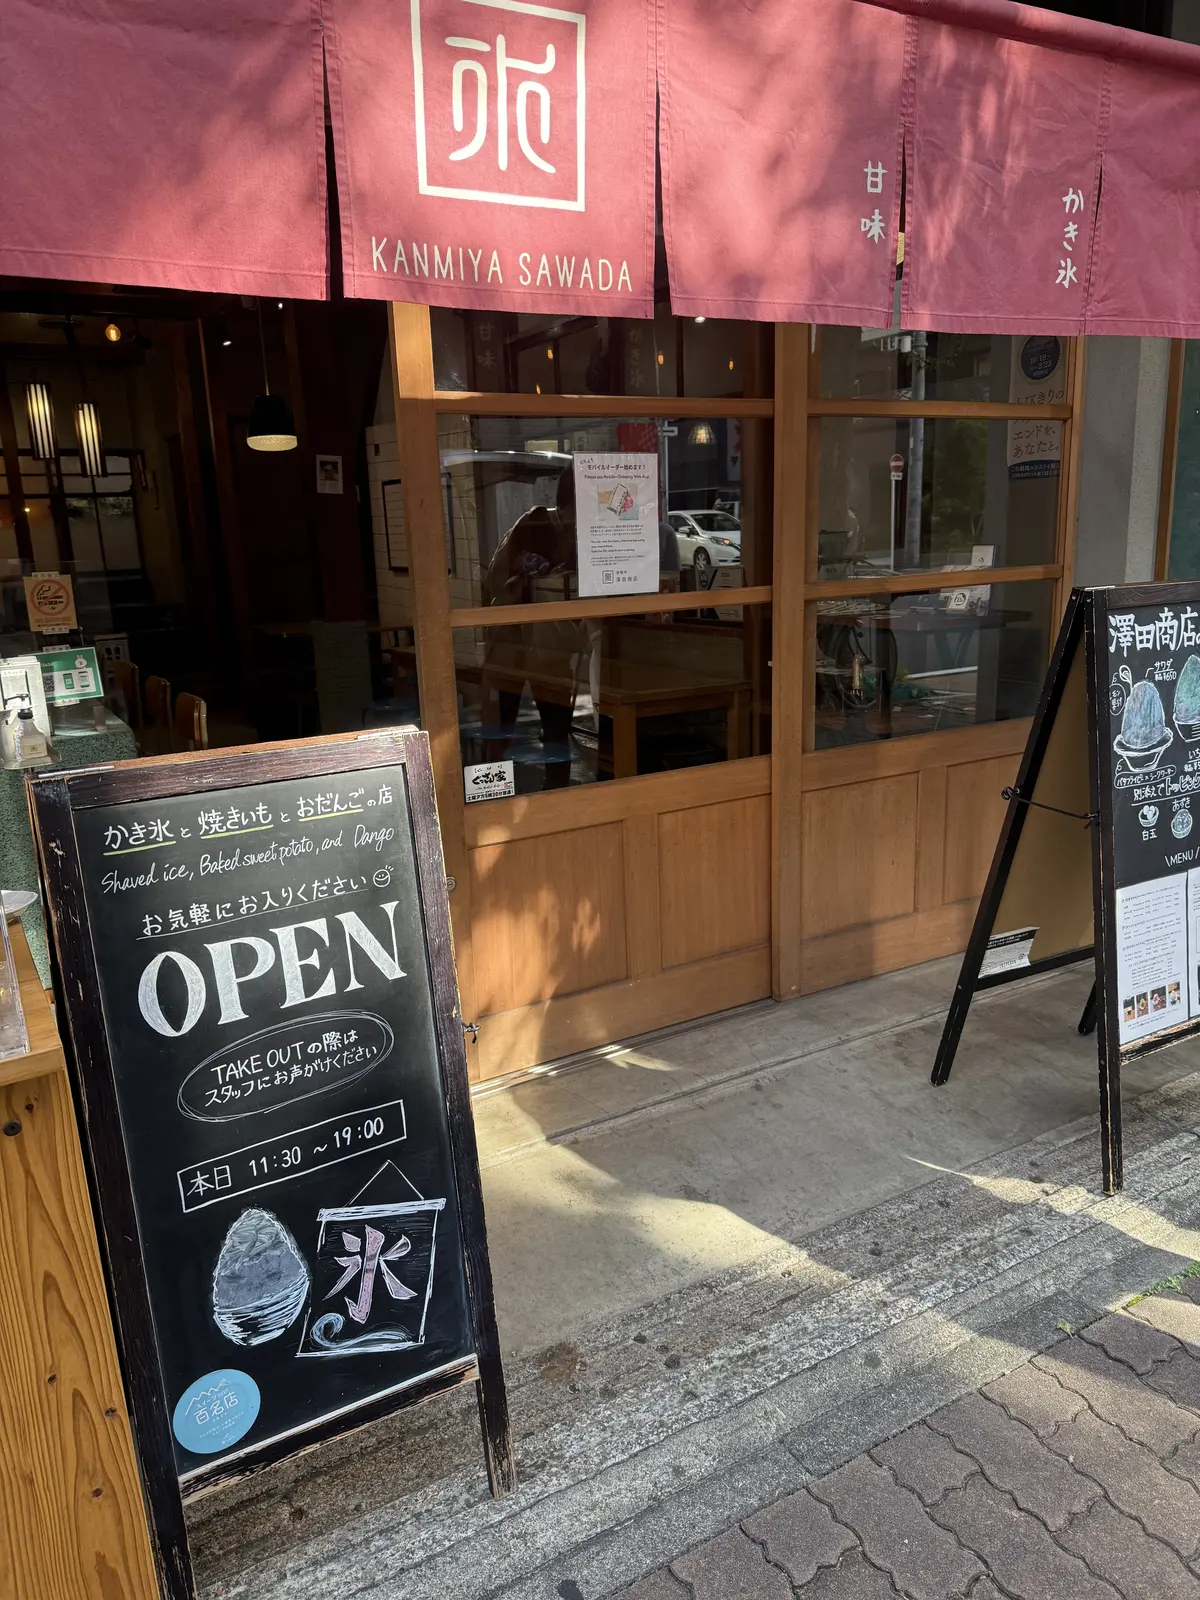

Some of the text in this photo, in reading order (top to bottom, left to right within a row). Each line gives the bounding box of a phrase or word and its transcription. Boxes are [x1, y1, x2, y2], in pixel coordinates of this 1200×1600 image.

[860, 160, 888, 244] 甘味
[371, 235, 634, 292] KANMIYA SAWADA
[1055, 187, 1085, 288] かき氷
[1012, 440, 1060, 459] あなたと。
[1142, 829, 1157, 841] 白玉
[1172, 797, 1191, 812] あずき
[101, 863, 158, 894] Shaved
[164, 863, 194, 881] ice,
[200, 848, 241, 876] Baked
[242, 841, 278, 866] sweet
[322, 830, 343, 850] and
[354, 824, 395, 851] Dango
[142, 875, 367, 936] お気軽にお入りください
[138, 900, 407, 1037] OPEN
[204, 1045, 378, 1107] スタッフにお声がけください
[211, 1054, 264, 1085] TAKE
[186, 1164, 232, 1196] 本日
[249, 1146, 302, 1177] 11:30
[333, 1117, 385, 1149] 19:00
[323, 1224, 418, 1324] 氷
[193, 1391, 239, 1425] 百名店
